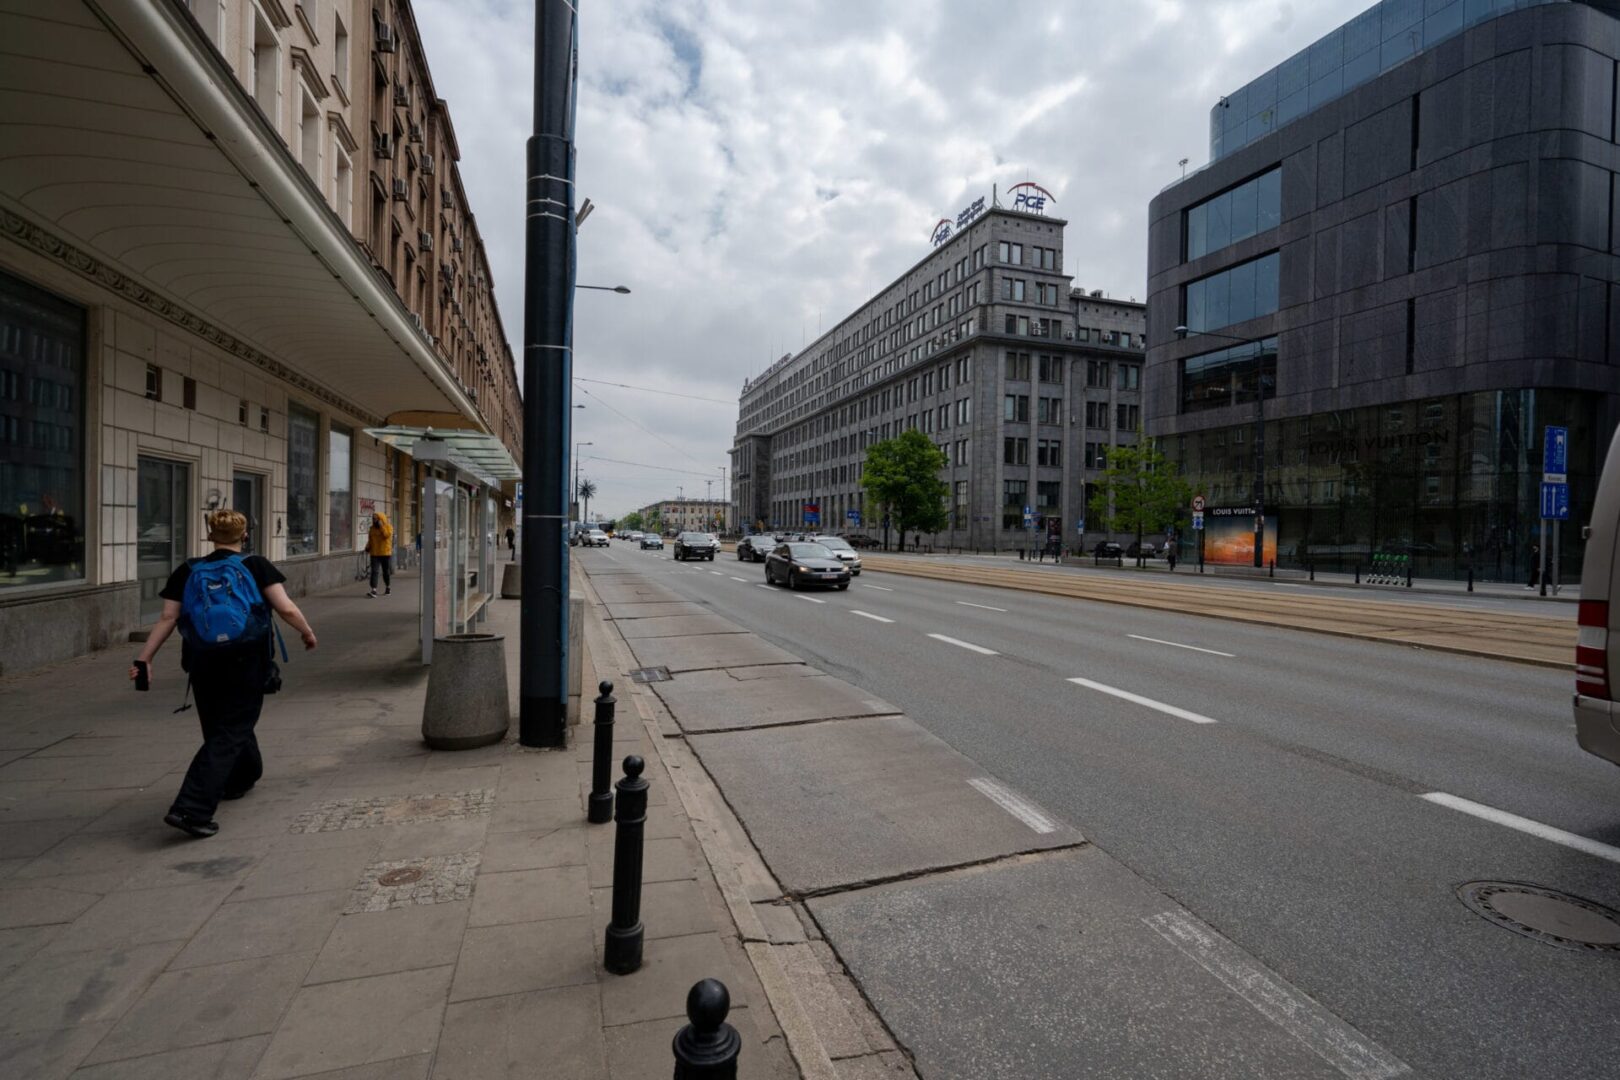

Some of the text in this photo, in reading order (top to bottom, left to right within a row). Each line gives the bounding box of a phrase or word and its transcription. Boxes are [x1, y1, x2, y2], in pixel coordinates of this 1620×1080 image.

[1015, 194, 1046, 210] PGE
[1310, 430, 1449, 454] LOUIS VUITTON
